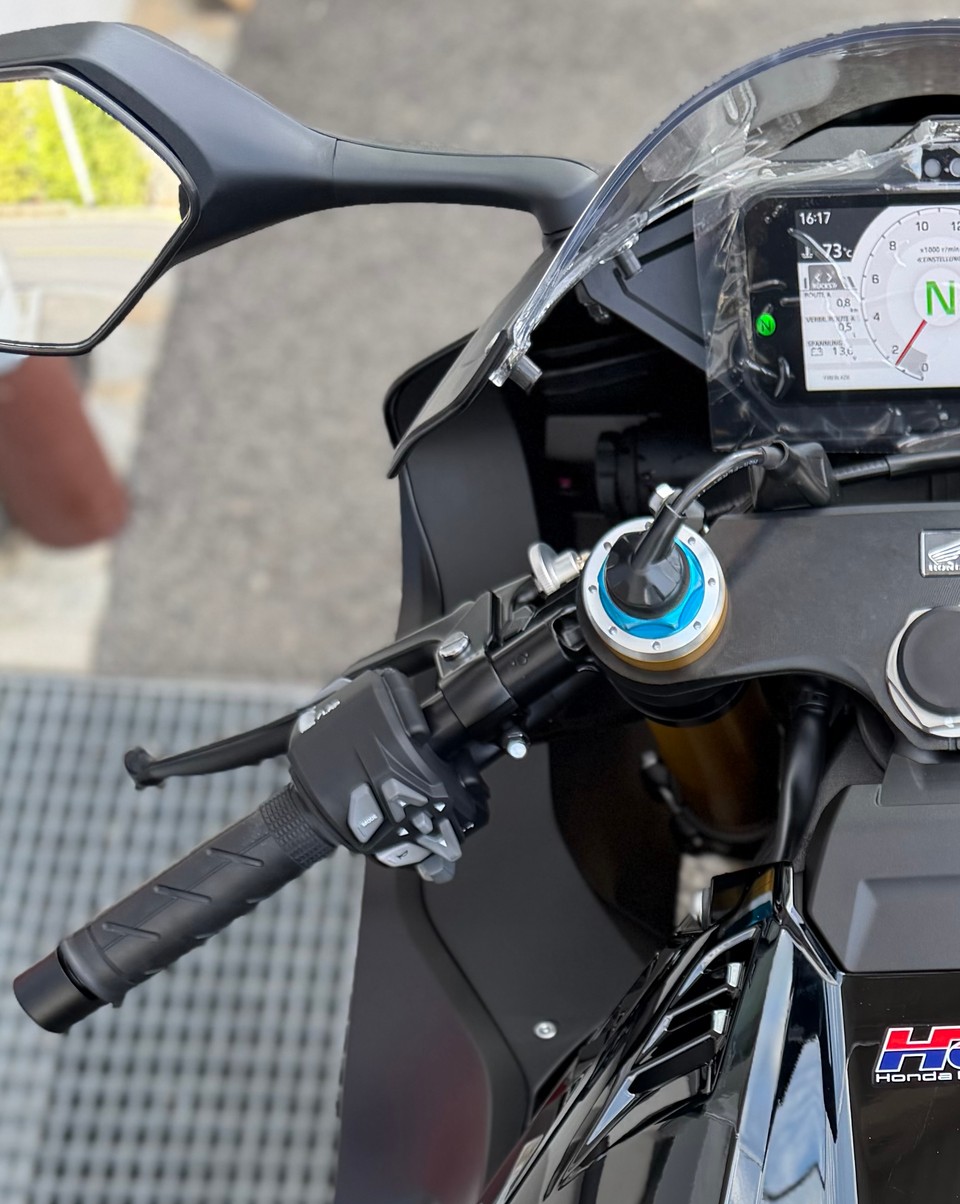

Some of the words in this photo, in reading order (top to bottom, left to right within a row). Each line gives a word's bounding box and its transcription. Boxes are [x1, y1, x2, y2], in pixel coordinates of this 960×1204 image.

[799, 211, 831, 225] 16:17
[915, 221, 929, 232] 10
[889, 240, 897, 251] 8
[871, 274, 879, 284] 6
[836, 298, 851, 308] 0,8
[925, 280, 956, 316] N
[873, 312, 881, 322] 4
[760, 319, 772, 332] N
[892, 345, 899, 355] 2
[921, 363, 929, 373] 0
[875, 1071, 952, 1083] Honda
